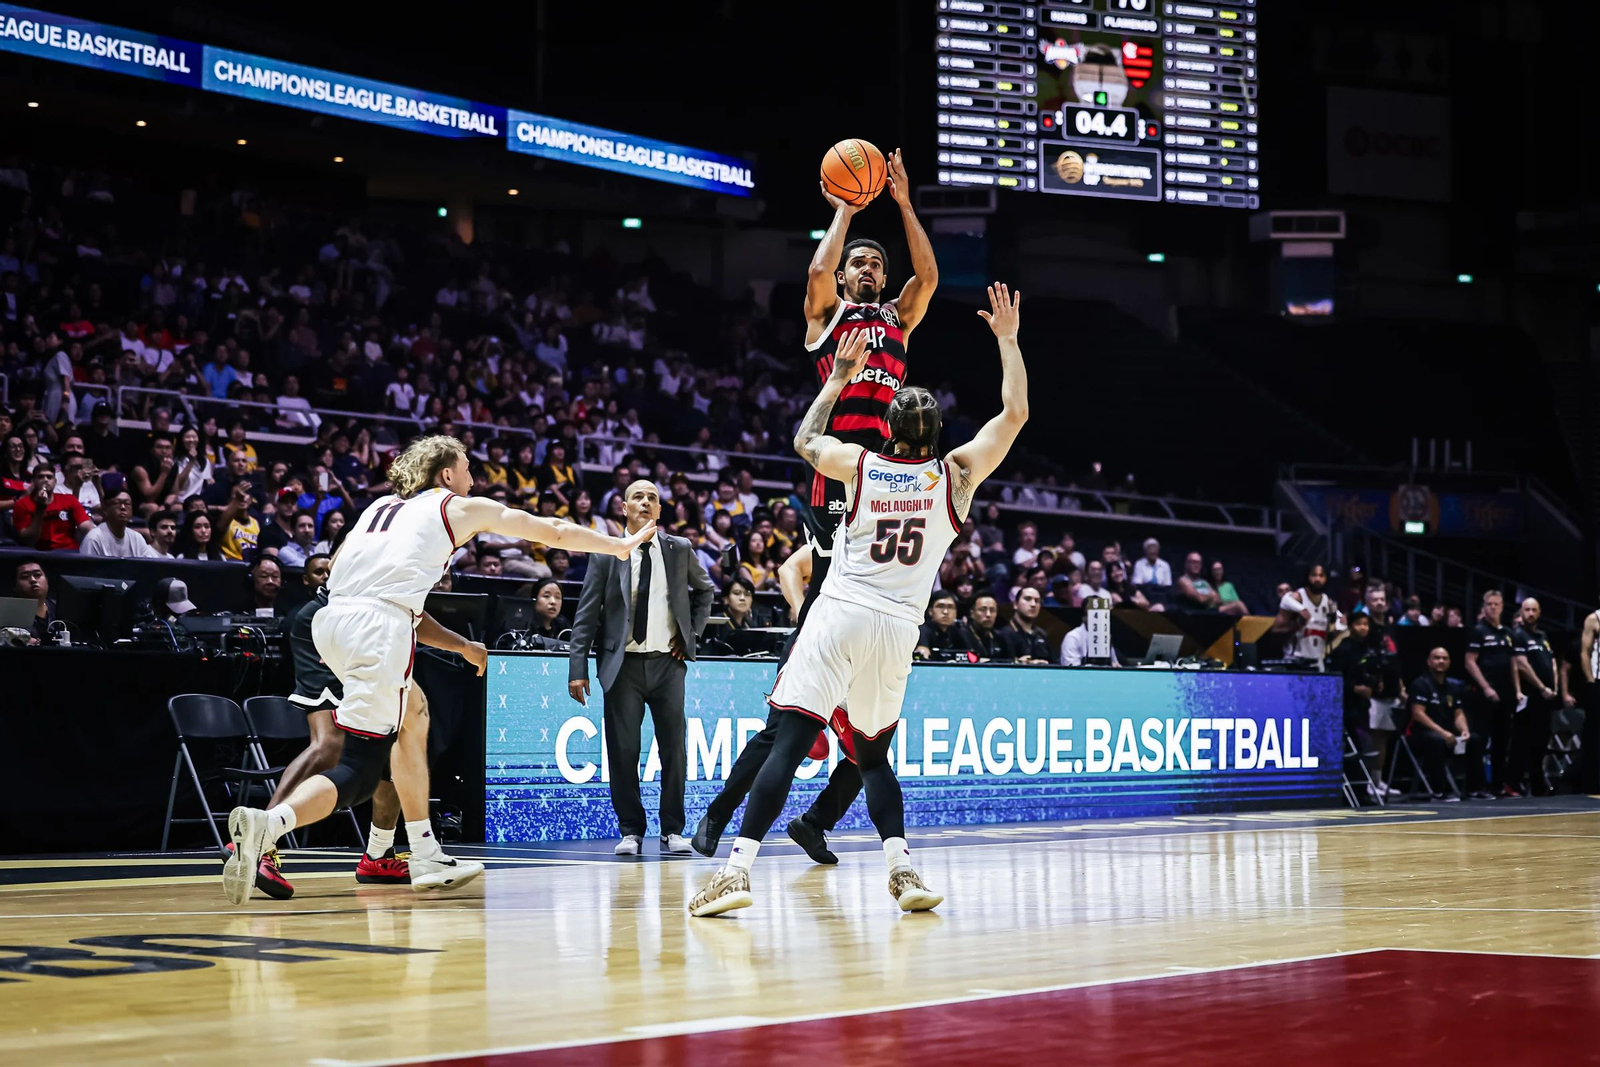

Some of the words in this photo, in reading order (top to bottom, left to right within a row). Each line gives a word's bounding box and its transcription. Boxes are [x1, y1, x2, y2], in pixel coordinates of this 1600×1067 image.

[214, 60, 499, 136] CHAMPIONSLEAGUE.BASKETBALL
[1076, 110, 1128, 137] 04.4
[517, 121, 755, 188] CHAMPIONSLEAGUE.BASKETBALL
[842, 140, 865, 171] Wils
[889, 482, 922, 493] Bank
[365, 502, 406, 534] 11
[870, 517, 926, 566] 55
[1093, 599, 1099, 609] 5
[1094, 612, 1098, 620] 4
[1093, 623, 1098, 632] 3
[1093, 635, 1098, 644] 2
[1094, 647, 1098, 655] 1
[554, 715, 1319, 786] CMLEAGUE.BASKETBALL
